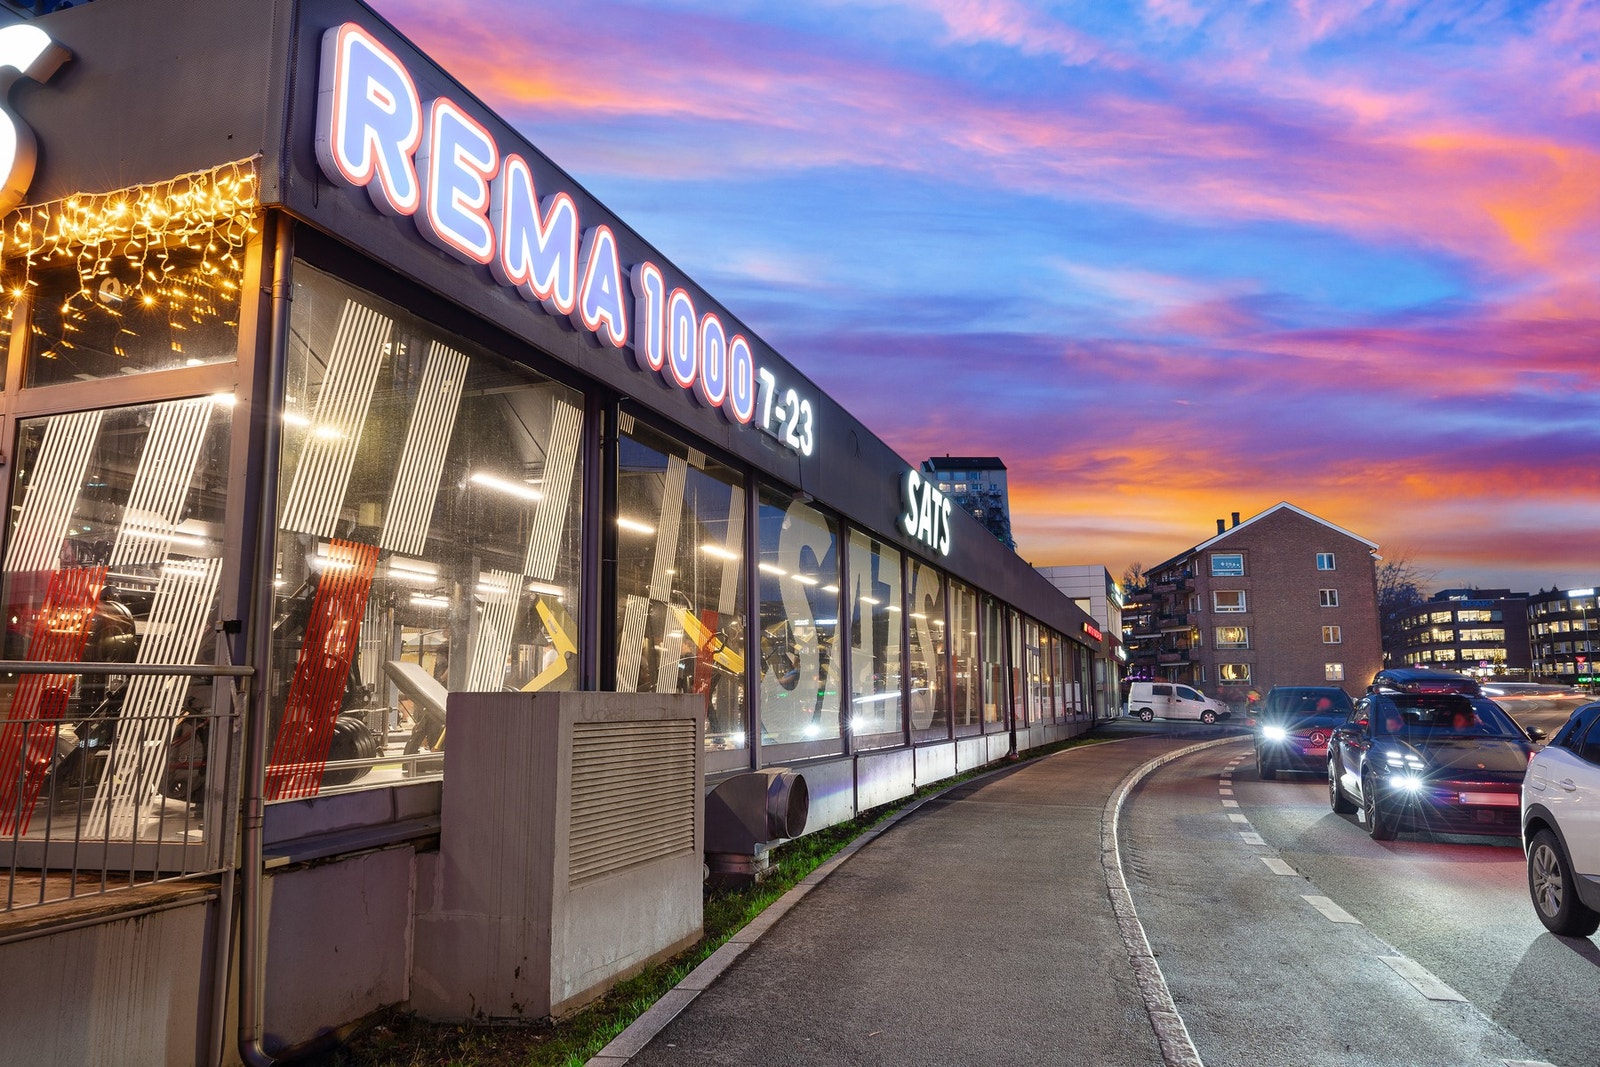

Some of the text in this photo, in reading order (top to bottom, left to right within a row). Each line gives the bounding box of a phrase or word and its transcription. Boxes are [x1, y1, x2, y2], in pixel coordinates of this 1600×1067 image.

[320, 21, 627, 348] REMA
[632, 260, 755, 424] 1000
[757, 366, 813, 457] 7-23
[904, 469, 951, 557] SATS
